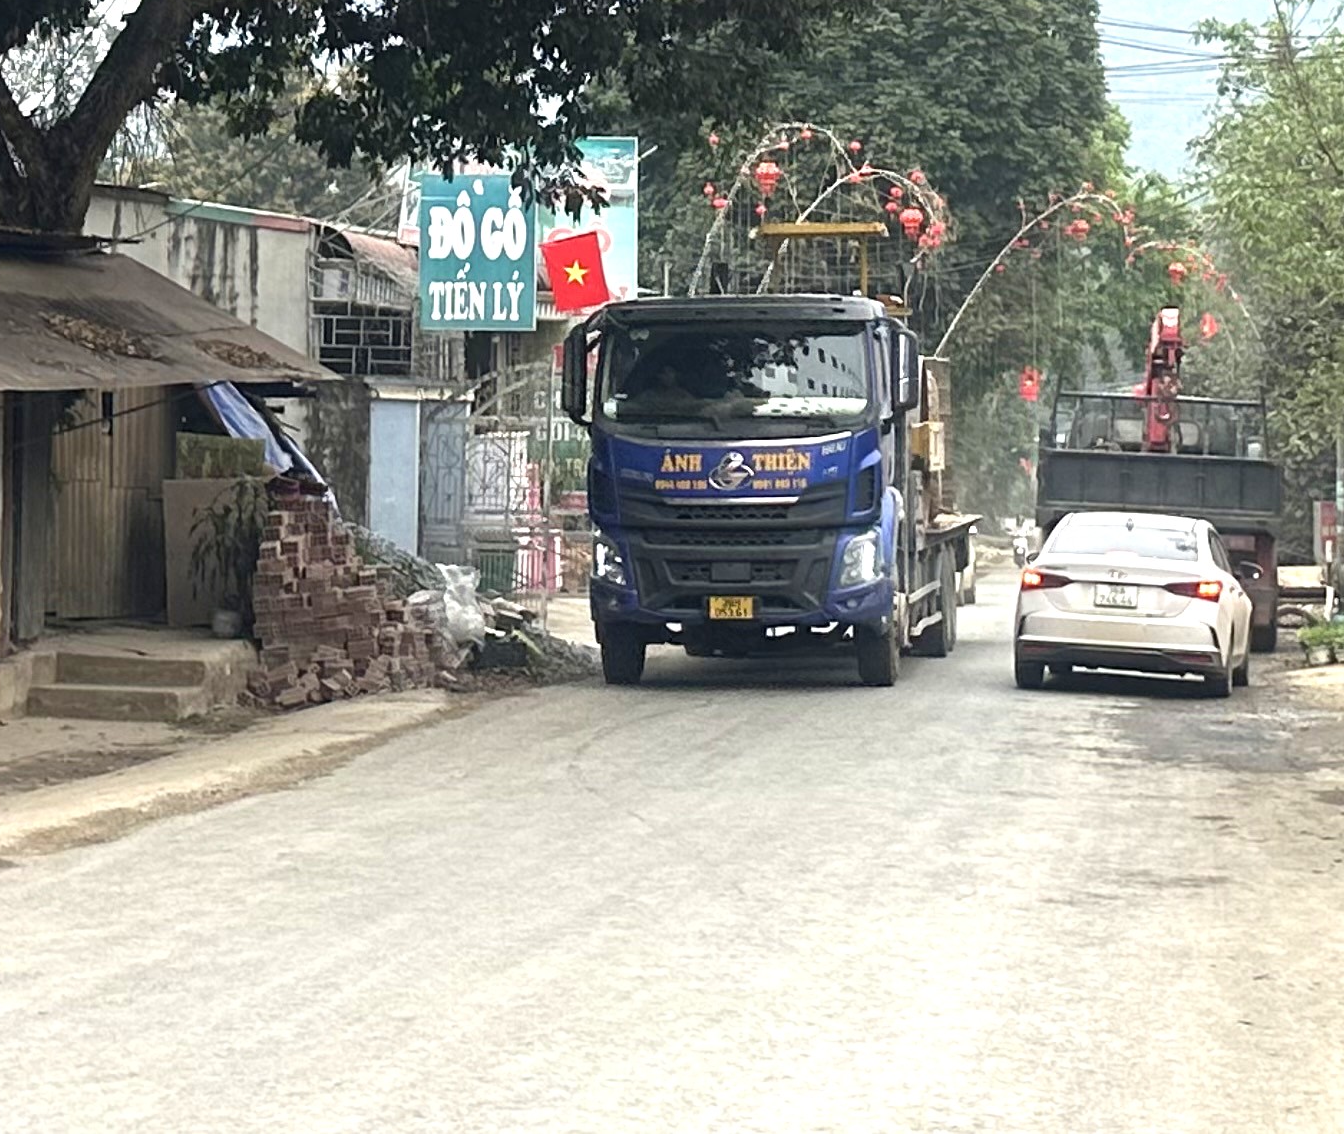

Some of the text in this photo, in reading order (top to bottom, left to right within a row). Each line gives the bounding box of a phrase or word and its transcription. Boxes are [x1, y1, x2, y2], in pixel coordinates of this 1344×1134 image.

[427, 178, 485, 260] ĐỒ
[480, 184, 528, 261] GỖ
[428, 261, 526, 322] TIẾN LÝ
